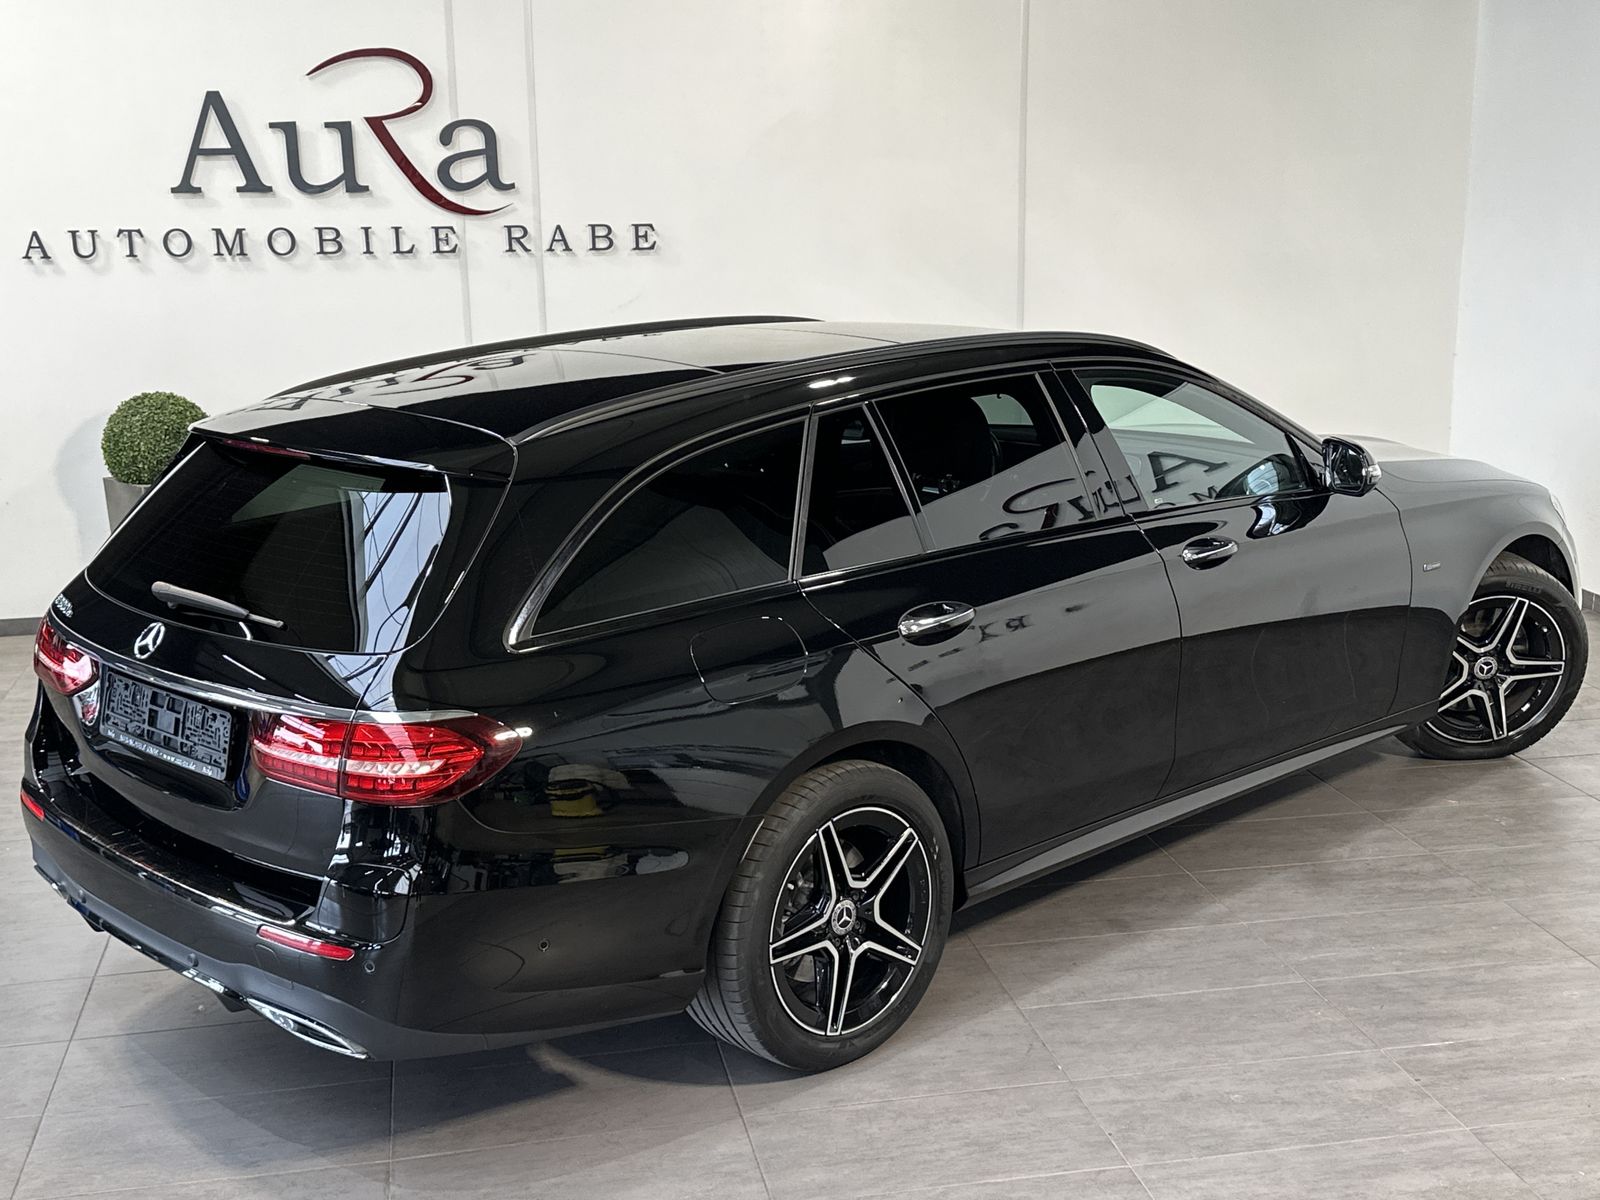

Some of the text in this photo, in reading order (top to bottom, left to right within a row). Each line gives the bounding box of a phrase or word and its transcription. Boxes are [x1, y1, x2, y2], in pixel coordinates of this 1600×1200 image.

[171, 48, 516, 217] AuRa
[22, 222, 658, 261] AUTOMOBILE RABE
